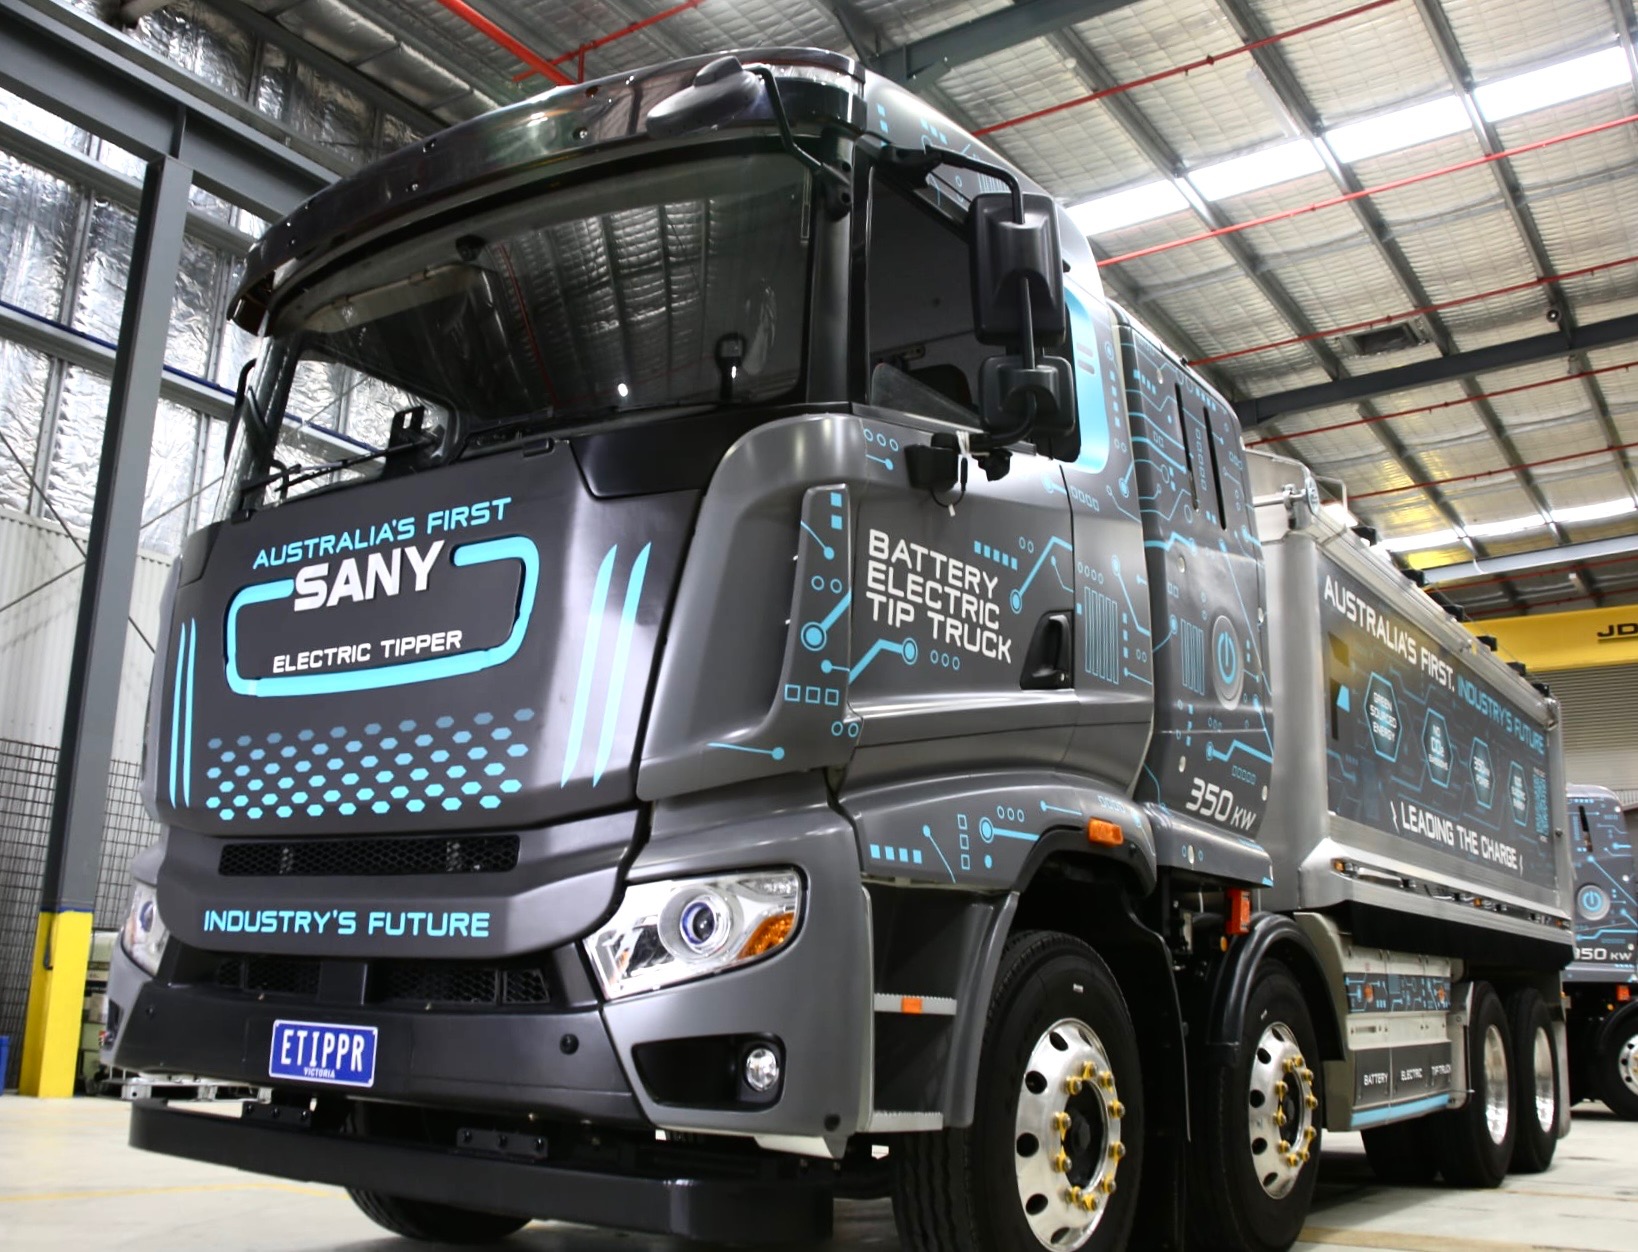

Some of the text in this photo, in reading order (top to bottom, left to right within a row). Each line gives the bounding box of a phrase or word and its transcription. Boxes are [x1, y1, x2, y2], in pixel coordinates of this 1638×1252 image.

[252, 497, 512, 569] AUSTRALIA'S FIRST
[869, 528, 998, 599] BATTERY
[294, 540, 445, 612] SANY
[867, 560, 1000, 630] ELECTRIC
[272, 630, 462, 673] ELECTRIC TIPPER
[866, 591, 1011, 664] TIP TRUCK
[1324, 575, 1417, 665] AUSTRALIA'S
[1457, 674, 1513, 733] INDUSTRY'S
[1514, 717, 1545, 755] FUTURE
[1185, 777, 1234, 822] 350
[1400, 801, 1518, 870] LEADING THE CHARGE
[203, 909, 490, 937] INDUSTRY'S FUTURE
[281, 1029, 365, 1072] ETIPPR
[303, 1066, 336, 1079] VICTORIA
[1363, 1072, 1388, 1086] BATTERY
[1400, 1067, 1423, 1081] ELECTRIC
